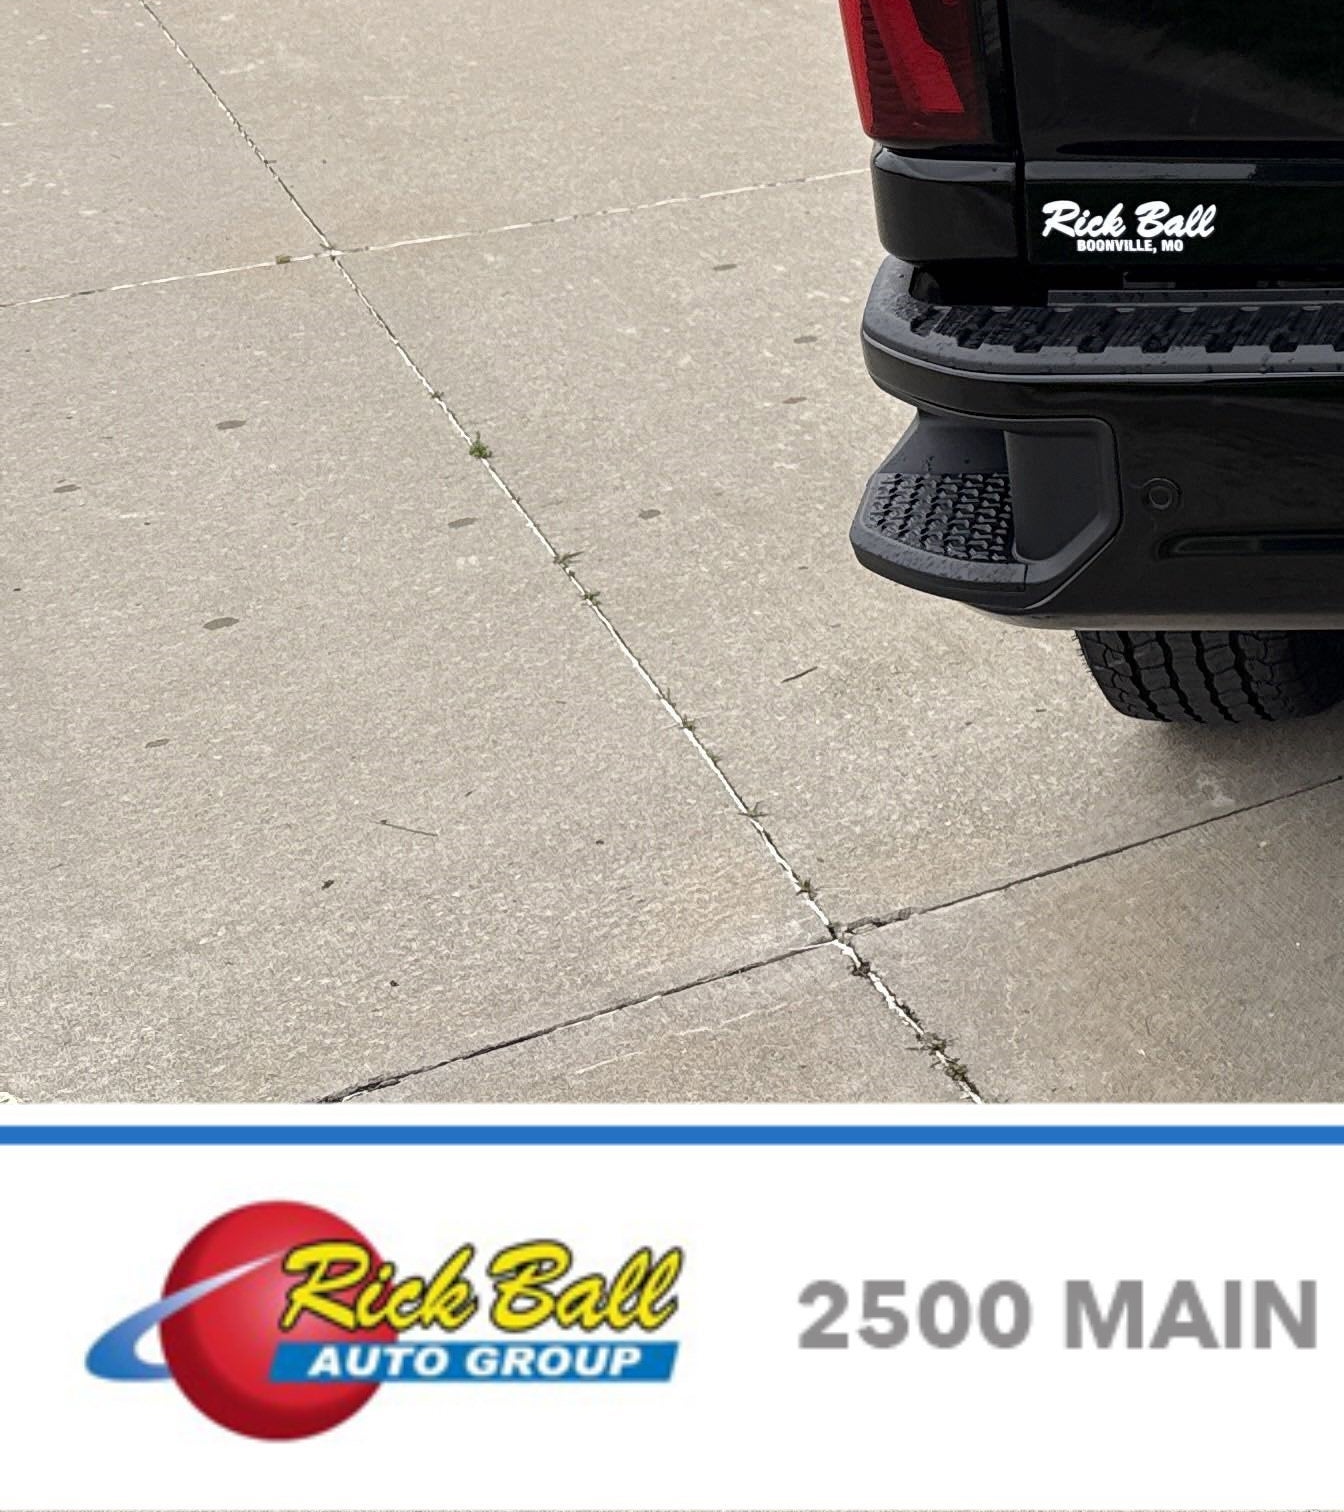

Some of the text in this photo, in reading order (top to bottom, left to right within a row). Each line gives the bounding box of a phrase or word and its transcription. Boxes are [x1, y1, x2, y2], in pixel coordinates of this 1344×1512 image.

[1041, 200, 1217, 238] Rick Ball
[1076, 239, 1184, 254] BOONVILLE, MO
